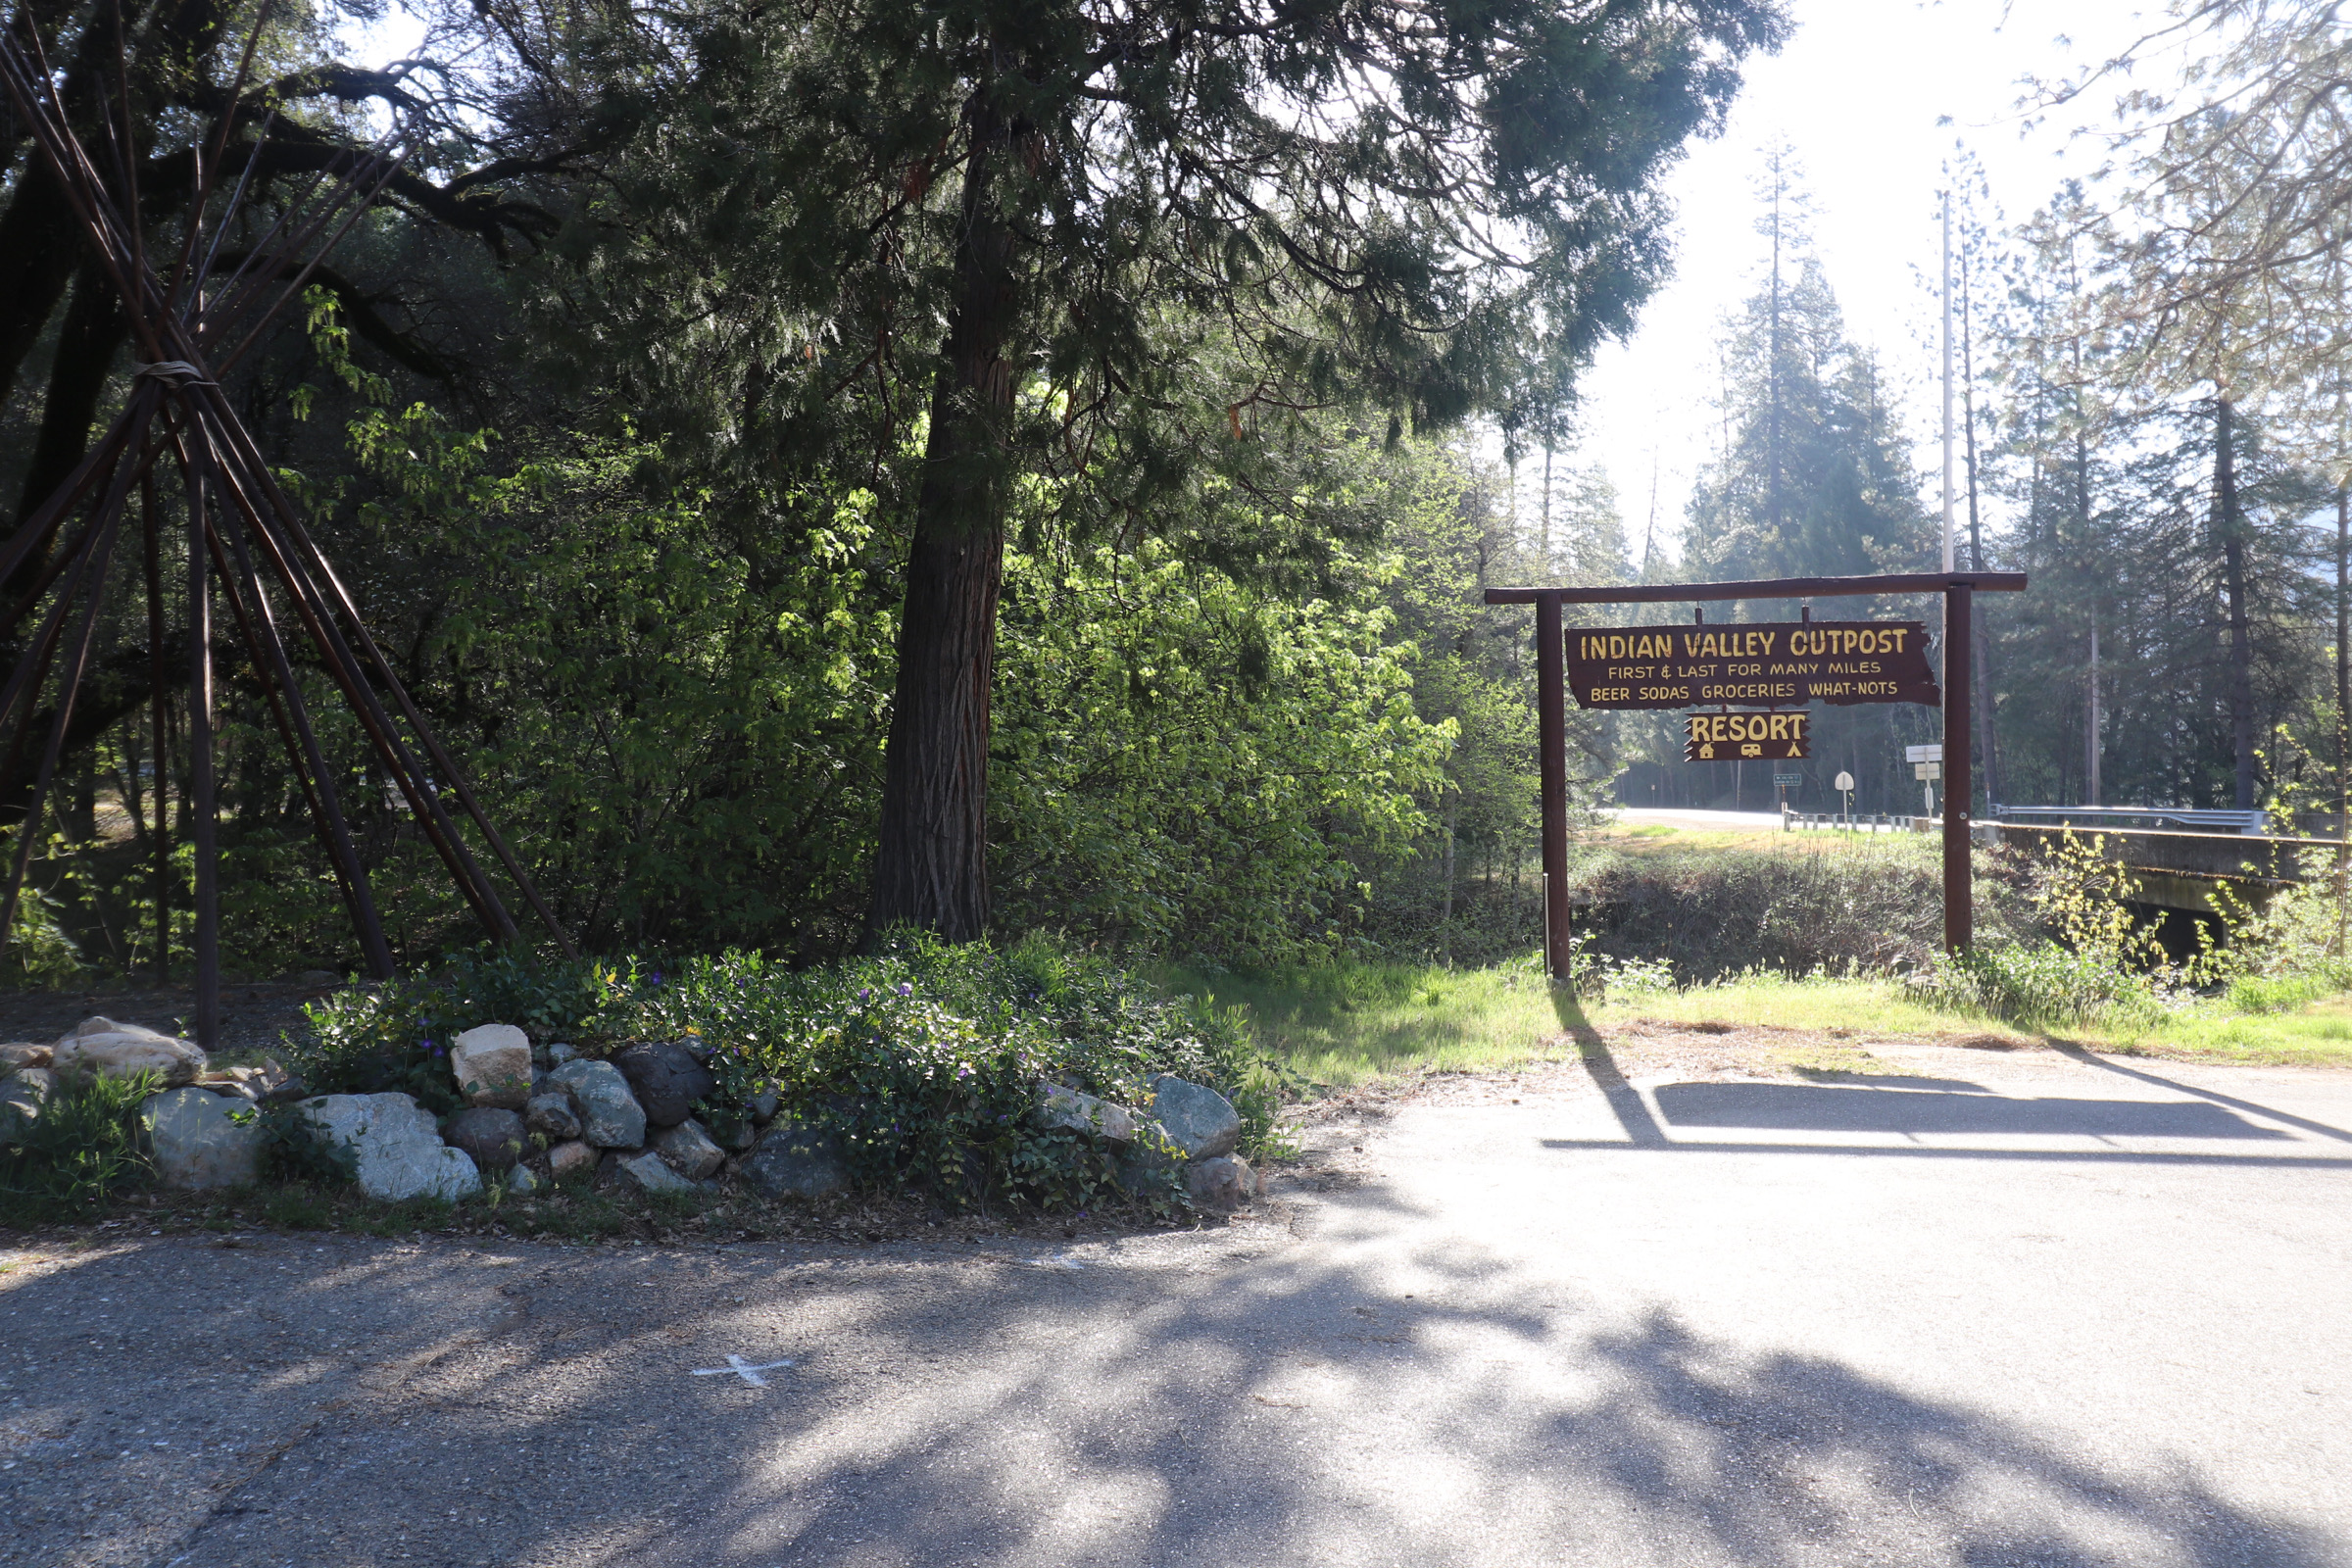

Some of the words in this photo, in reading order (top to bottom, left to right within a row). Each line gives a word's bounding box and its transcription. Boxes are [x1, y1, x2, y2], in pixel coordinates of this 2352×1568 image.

[1581, 634, 1672, 660] INDIAN
[1685, 631, 1776, 658] VALLEY
[1789, 628, 1908, 657] OUTPOST
[1607, 665, 1655, 680] FIRST
[1660, 665, 1672, 679] &
[1678, 664, 1717, 678] LAST
[1728, 663, 1762, 676] FOR
[1769, 663, 1820, 675] MANY
[1828, 662, 1882, 674] MILES
[1591, 687, 1630, 702] BEER
[1640, 686, 1690, 700] SODAS
[1701, 683, 1796, 699] GROCERIES
[1809, 681, 1898, 695] WHAT-NOTS
[1691, 714, 1806, 742] RESORT
